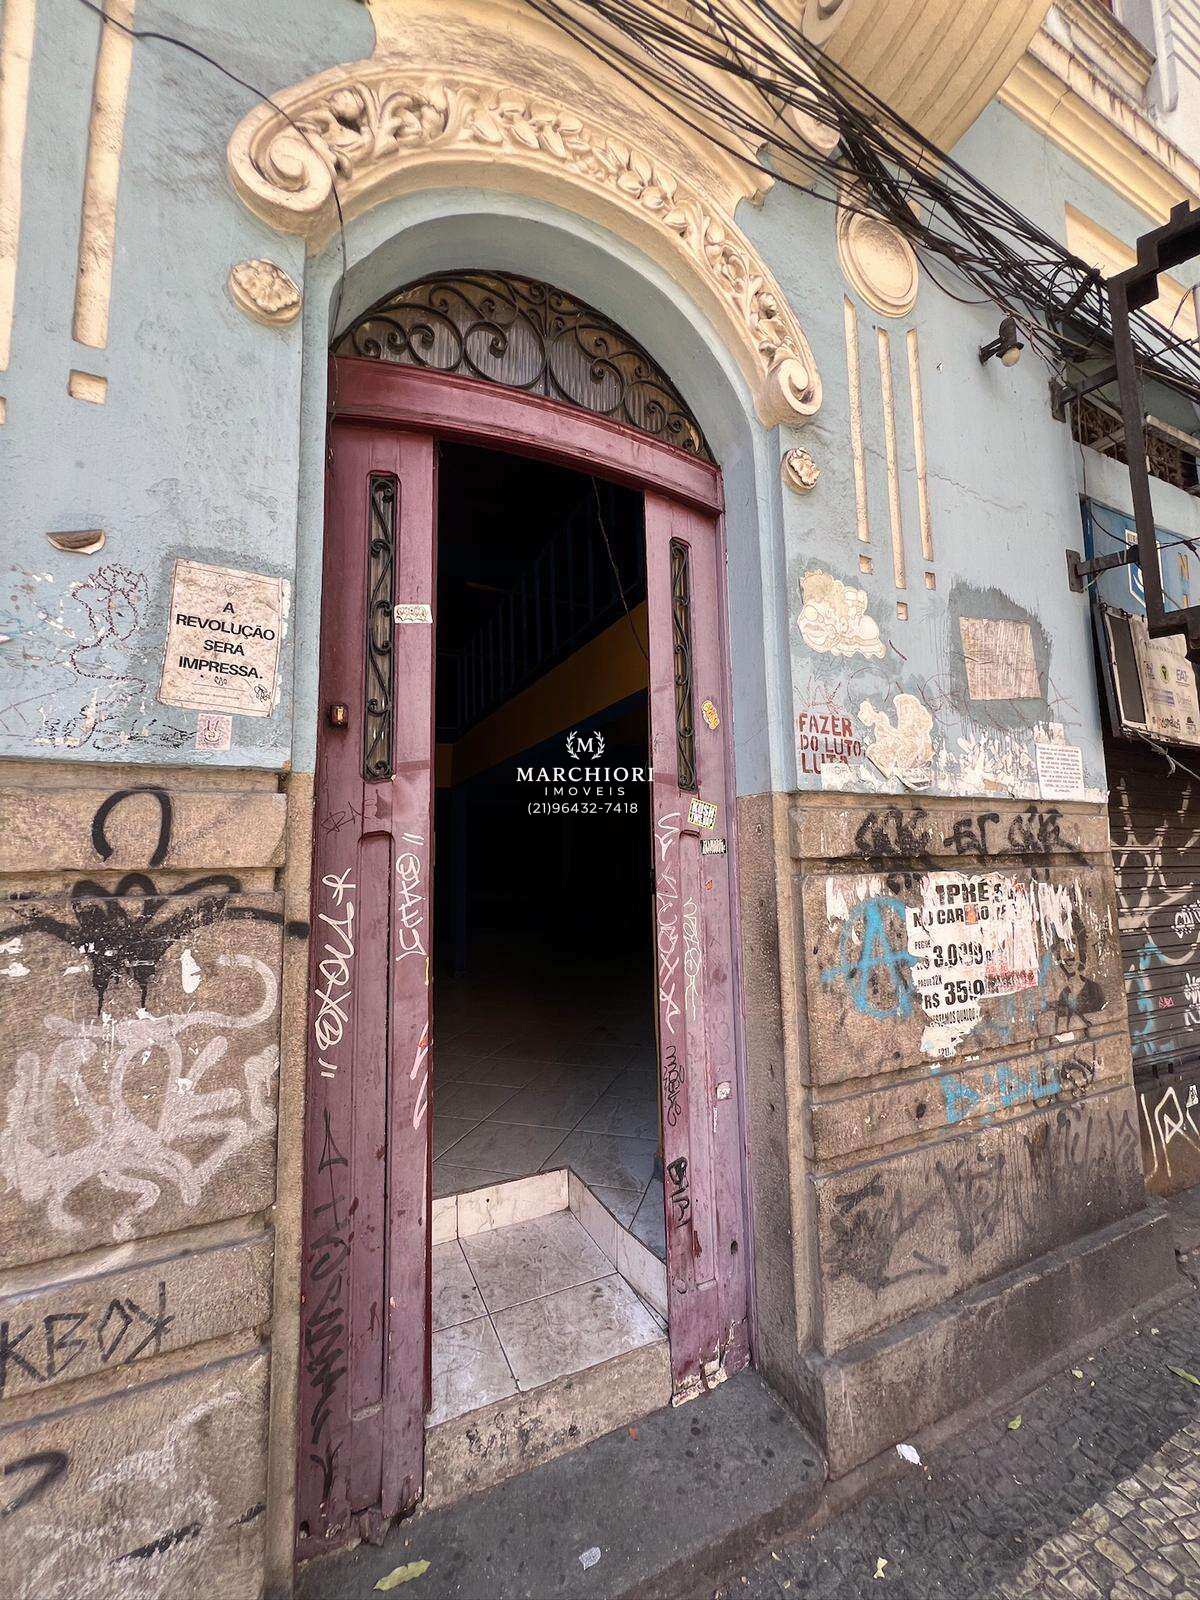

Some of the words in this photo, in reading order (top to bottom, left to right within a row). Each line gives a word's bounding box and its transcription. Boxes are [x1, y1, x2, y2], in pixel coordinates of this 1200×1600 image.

[222, 602, 235, 614] A
[176, 613, 275, 641] REVOLUÇÃO
[203, 640, 245, 656] SERÁ
[178, 656, 264, 679] IMPRESSA.
[799, 712, 853, 737] FAZER
[800, 734, 819, 752] DO
[924, 993, 940, 1009] R$
